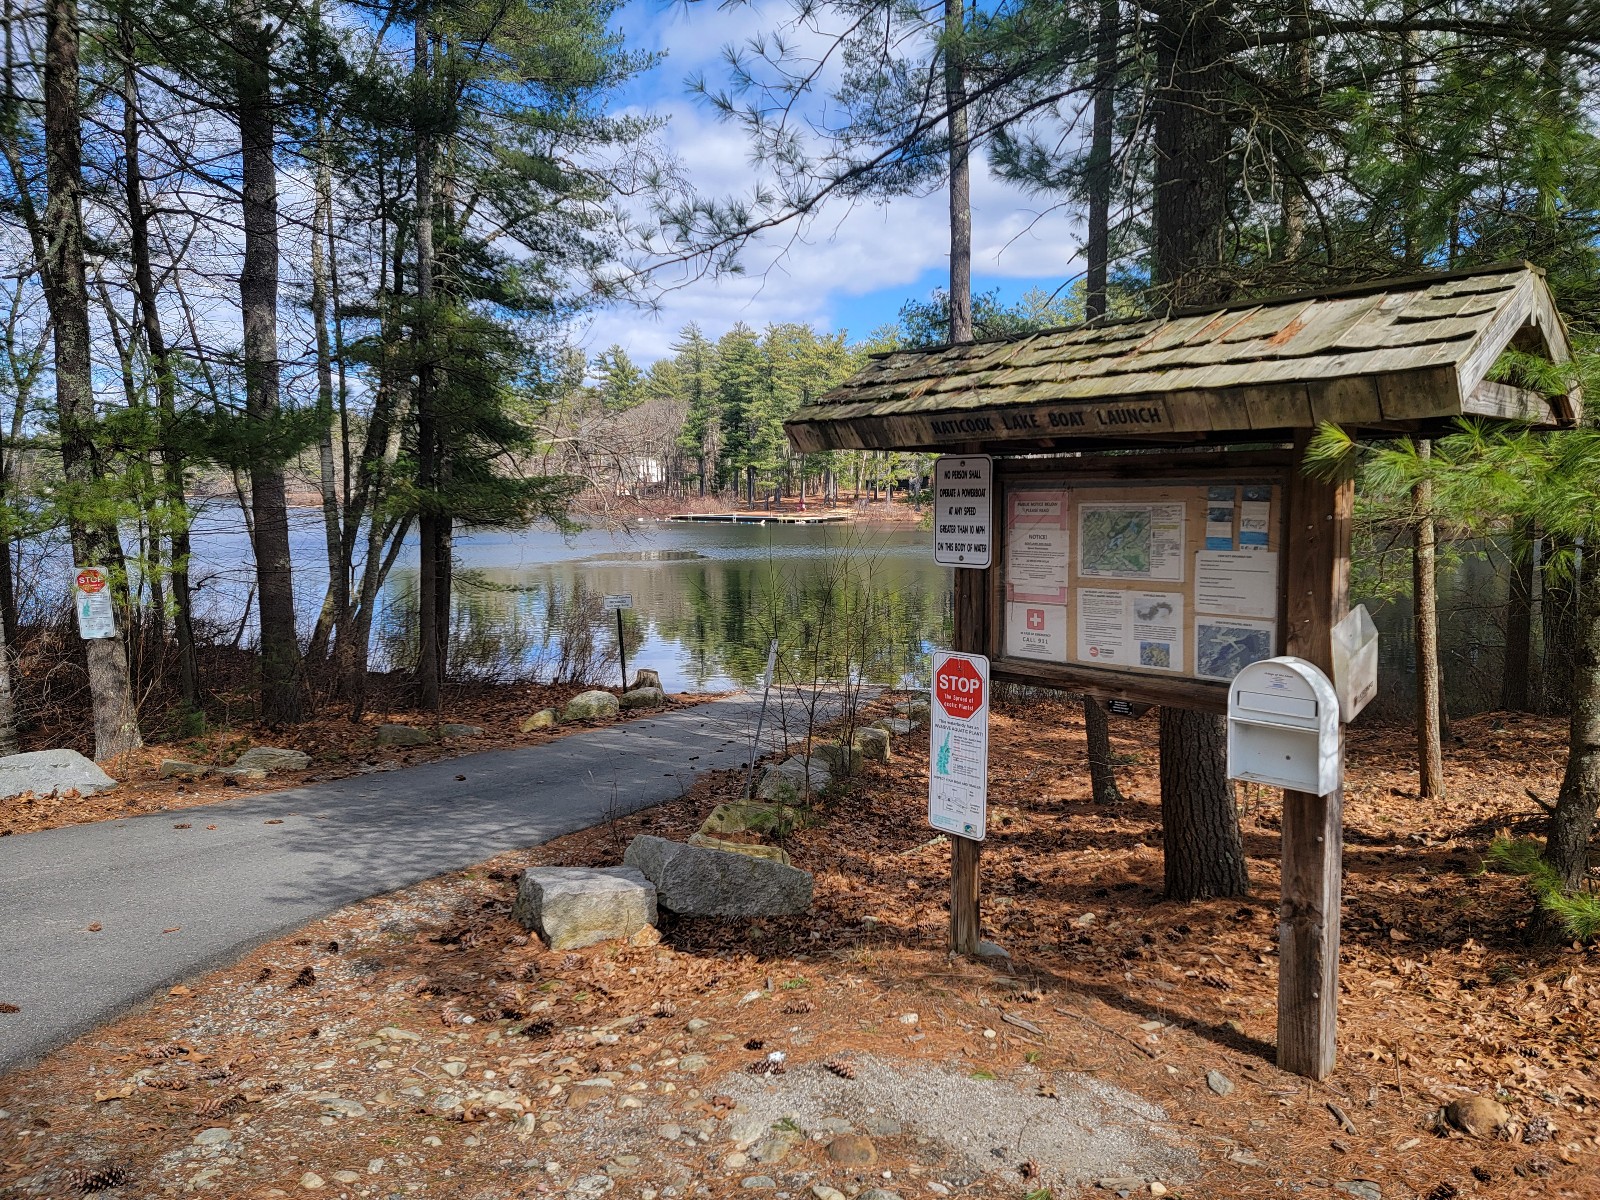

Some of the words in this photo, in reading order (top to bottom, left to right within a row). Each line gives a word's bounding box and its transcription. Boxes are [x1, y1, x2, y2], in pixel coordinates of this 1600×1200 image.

[930, 416, 995, 435] NATICOOK
[1002, 412, 1040, 430] LAKE
[1048, 410, 1086, 428] BOAT
[1097, 408, 1162, 425] LAUNCH
[944, 470, 950, 479] NO
[952, 470, 967, 480] PERSON
[968, 470, 982, 479] SHALL
[940, 488, 956, 498] OPERATE
[957, 489, 960, 498] A
[962, 488, 986, 498] POWERBOAT
[948, 507, 953, 515] AT
[954, 507, 963, 515] ANY
[964, 507, 976, 516] SPEED
[940, 525, 956, 534] GREATER
[957, 525, 968, 534] THAN
[970, 525, 974, 534] 10
[976, 526, 985, 534] MPH
[938, 542, 944, 551] ON
[945, 543, 953, 551] THIS
[955, 543, 966, 552] BODY
[967, 544, 973, 552] OF
[974, 544, 987, 553] WATER
[939, 674, 980, 693] STOP
